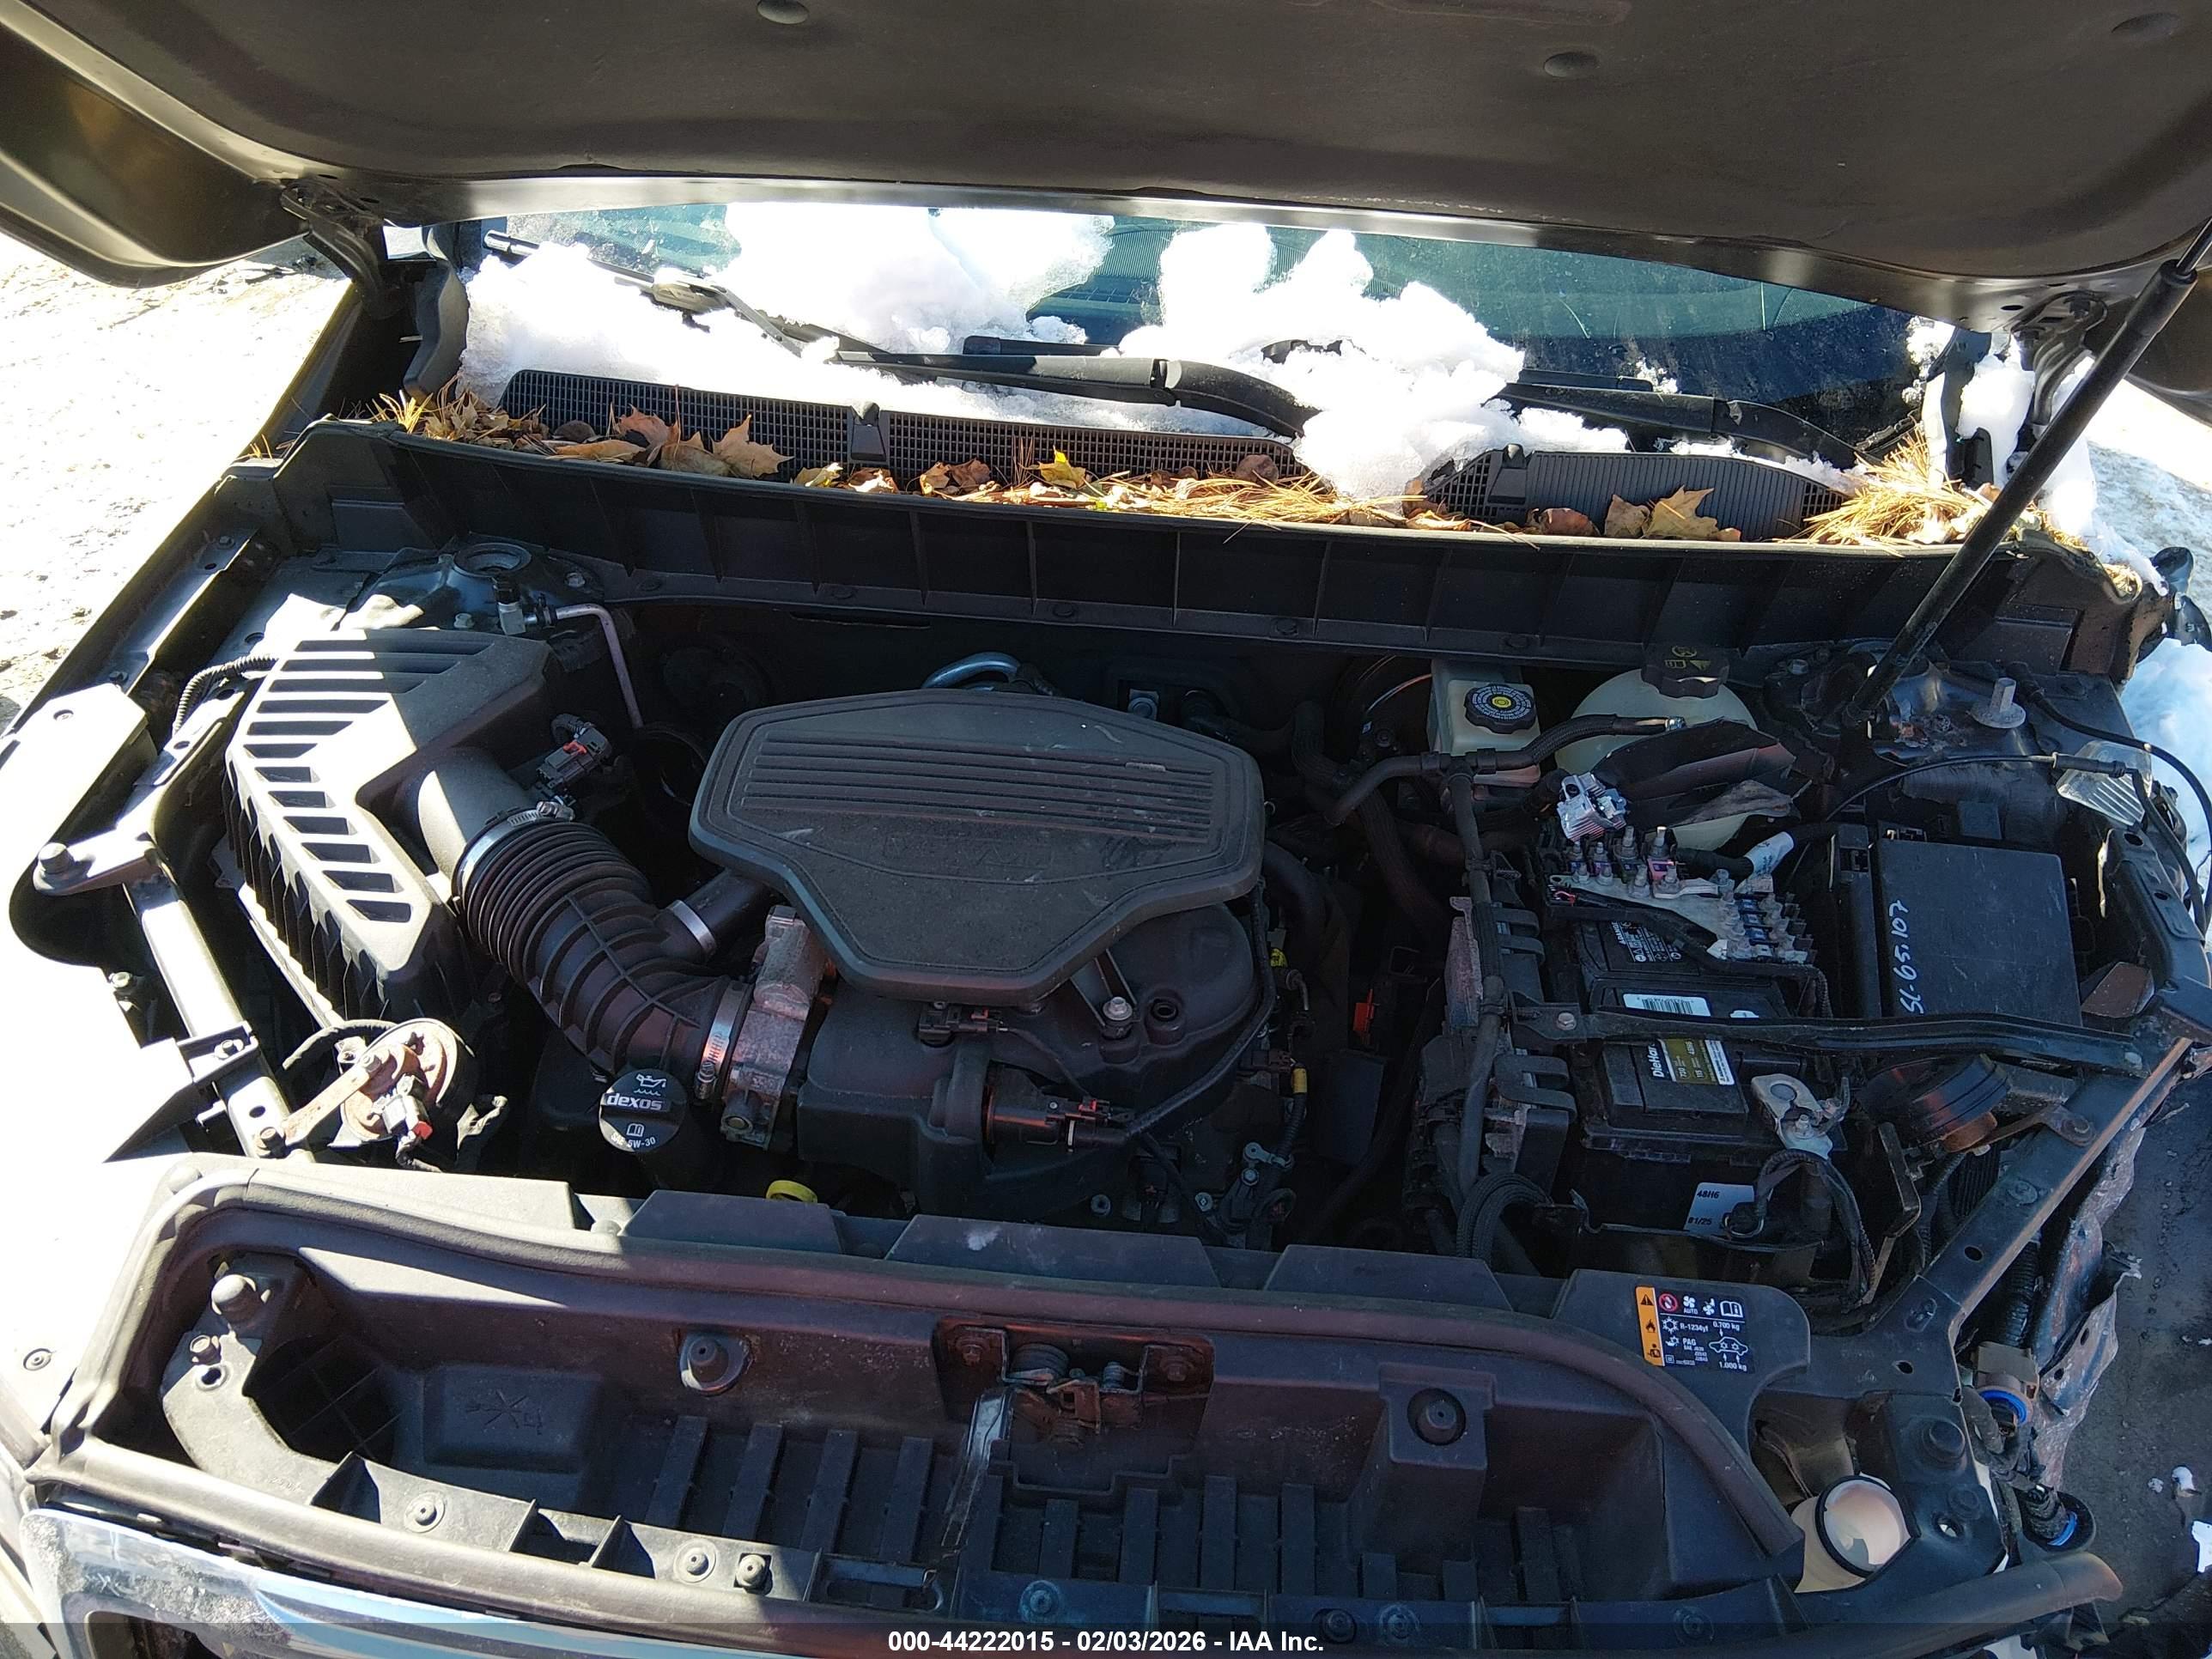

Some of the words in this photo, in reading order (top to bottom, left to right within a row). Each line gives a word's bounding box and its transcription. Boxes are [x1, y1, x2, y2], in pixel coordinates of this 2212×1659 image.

[1611, 921, 1624, 940] DANGE
[606, 1092, 663, 1110] dexos
[611, 1132, 626, 1146] SAE
[627, 1137, 656, 1148] 5W-30
[1697, 1190, 1720, 1199] 48H6
[1719, 1361, 1737, 1370] 1.000
[1738, 1363, 1747, 1372] kg
